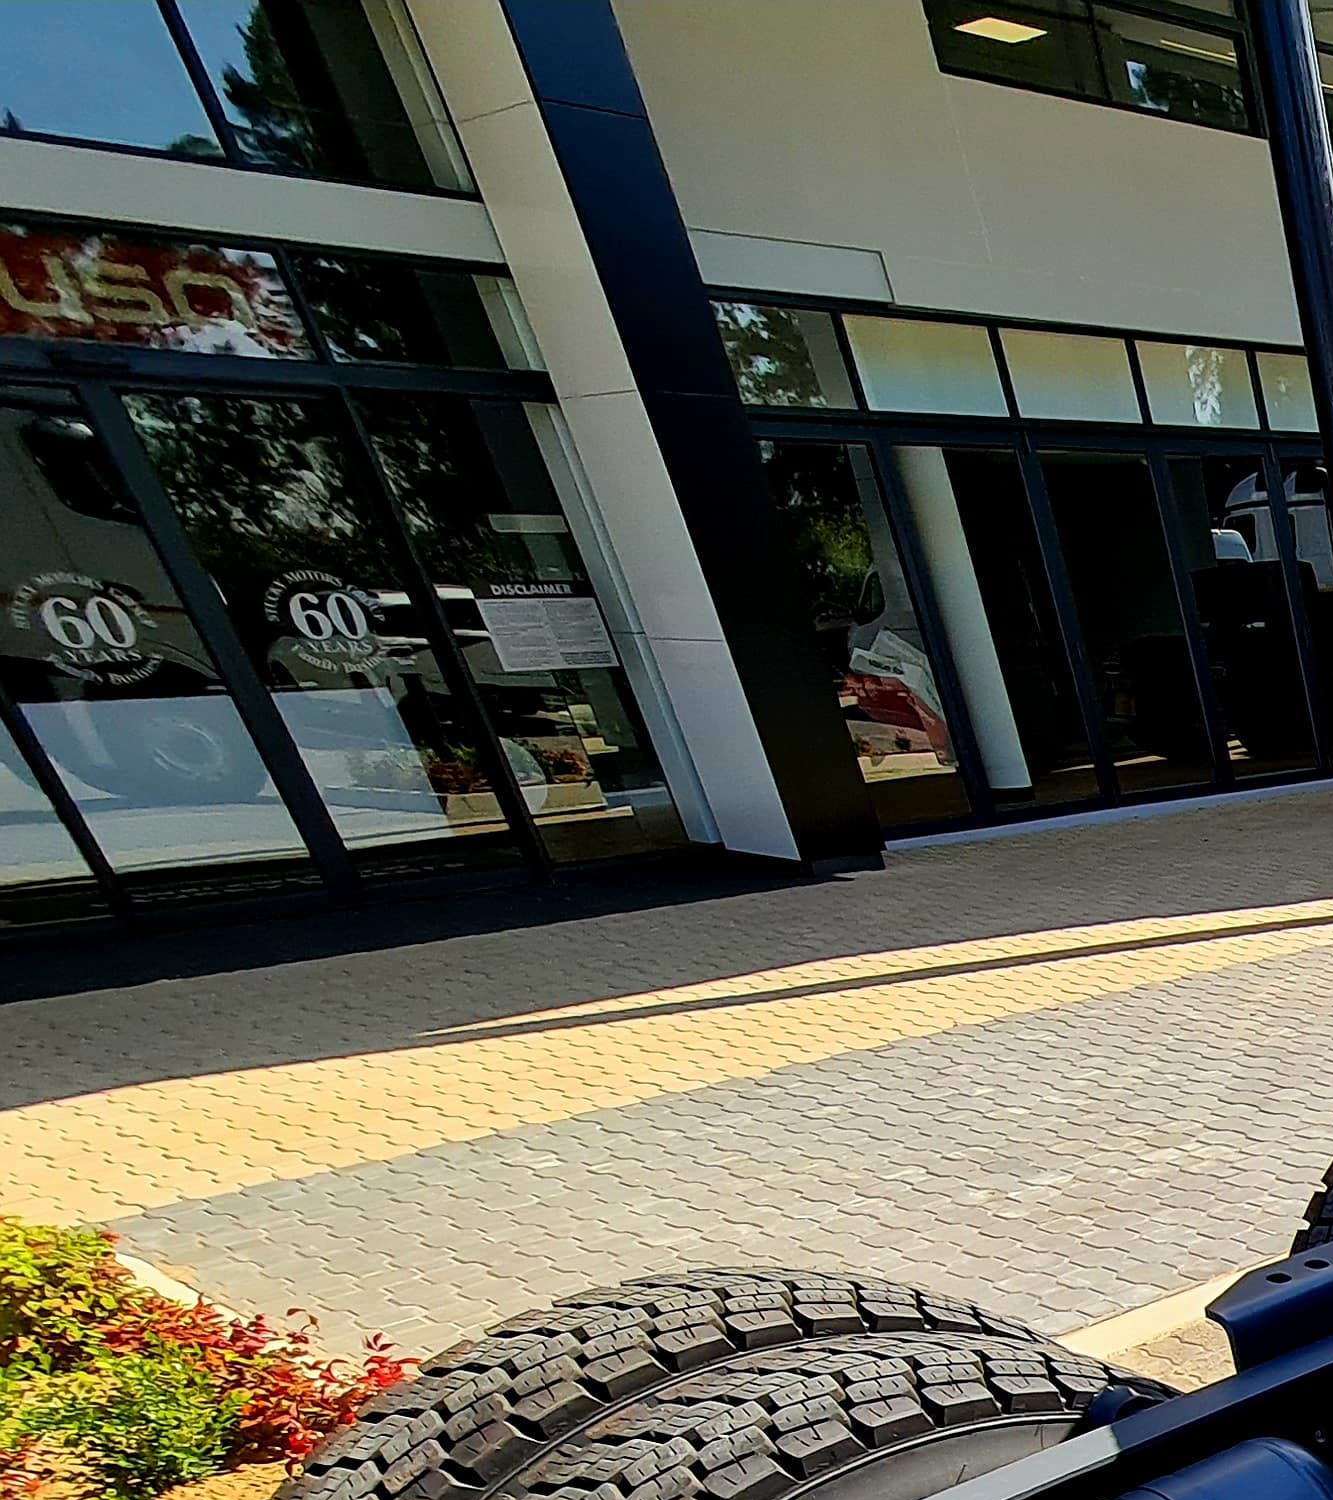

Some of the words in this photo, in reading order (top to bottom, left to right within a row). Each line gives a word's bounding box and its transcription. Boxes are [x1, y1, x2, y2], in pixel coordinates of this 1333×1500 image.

[282, 569, 343, 588] MOTORS
[489, 583, 574, 596] DISCLAIMER
[40, 595, 137, 649] 60
[289, 592, 368, 641] 60
[309, 639, 373, 654] YEARS
